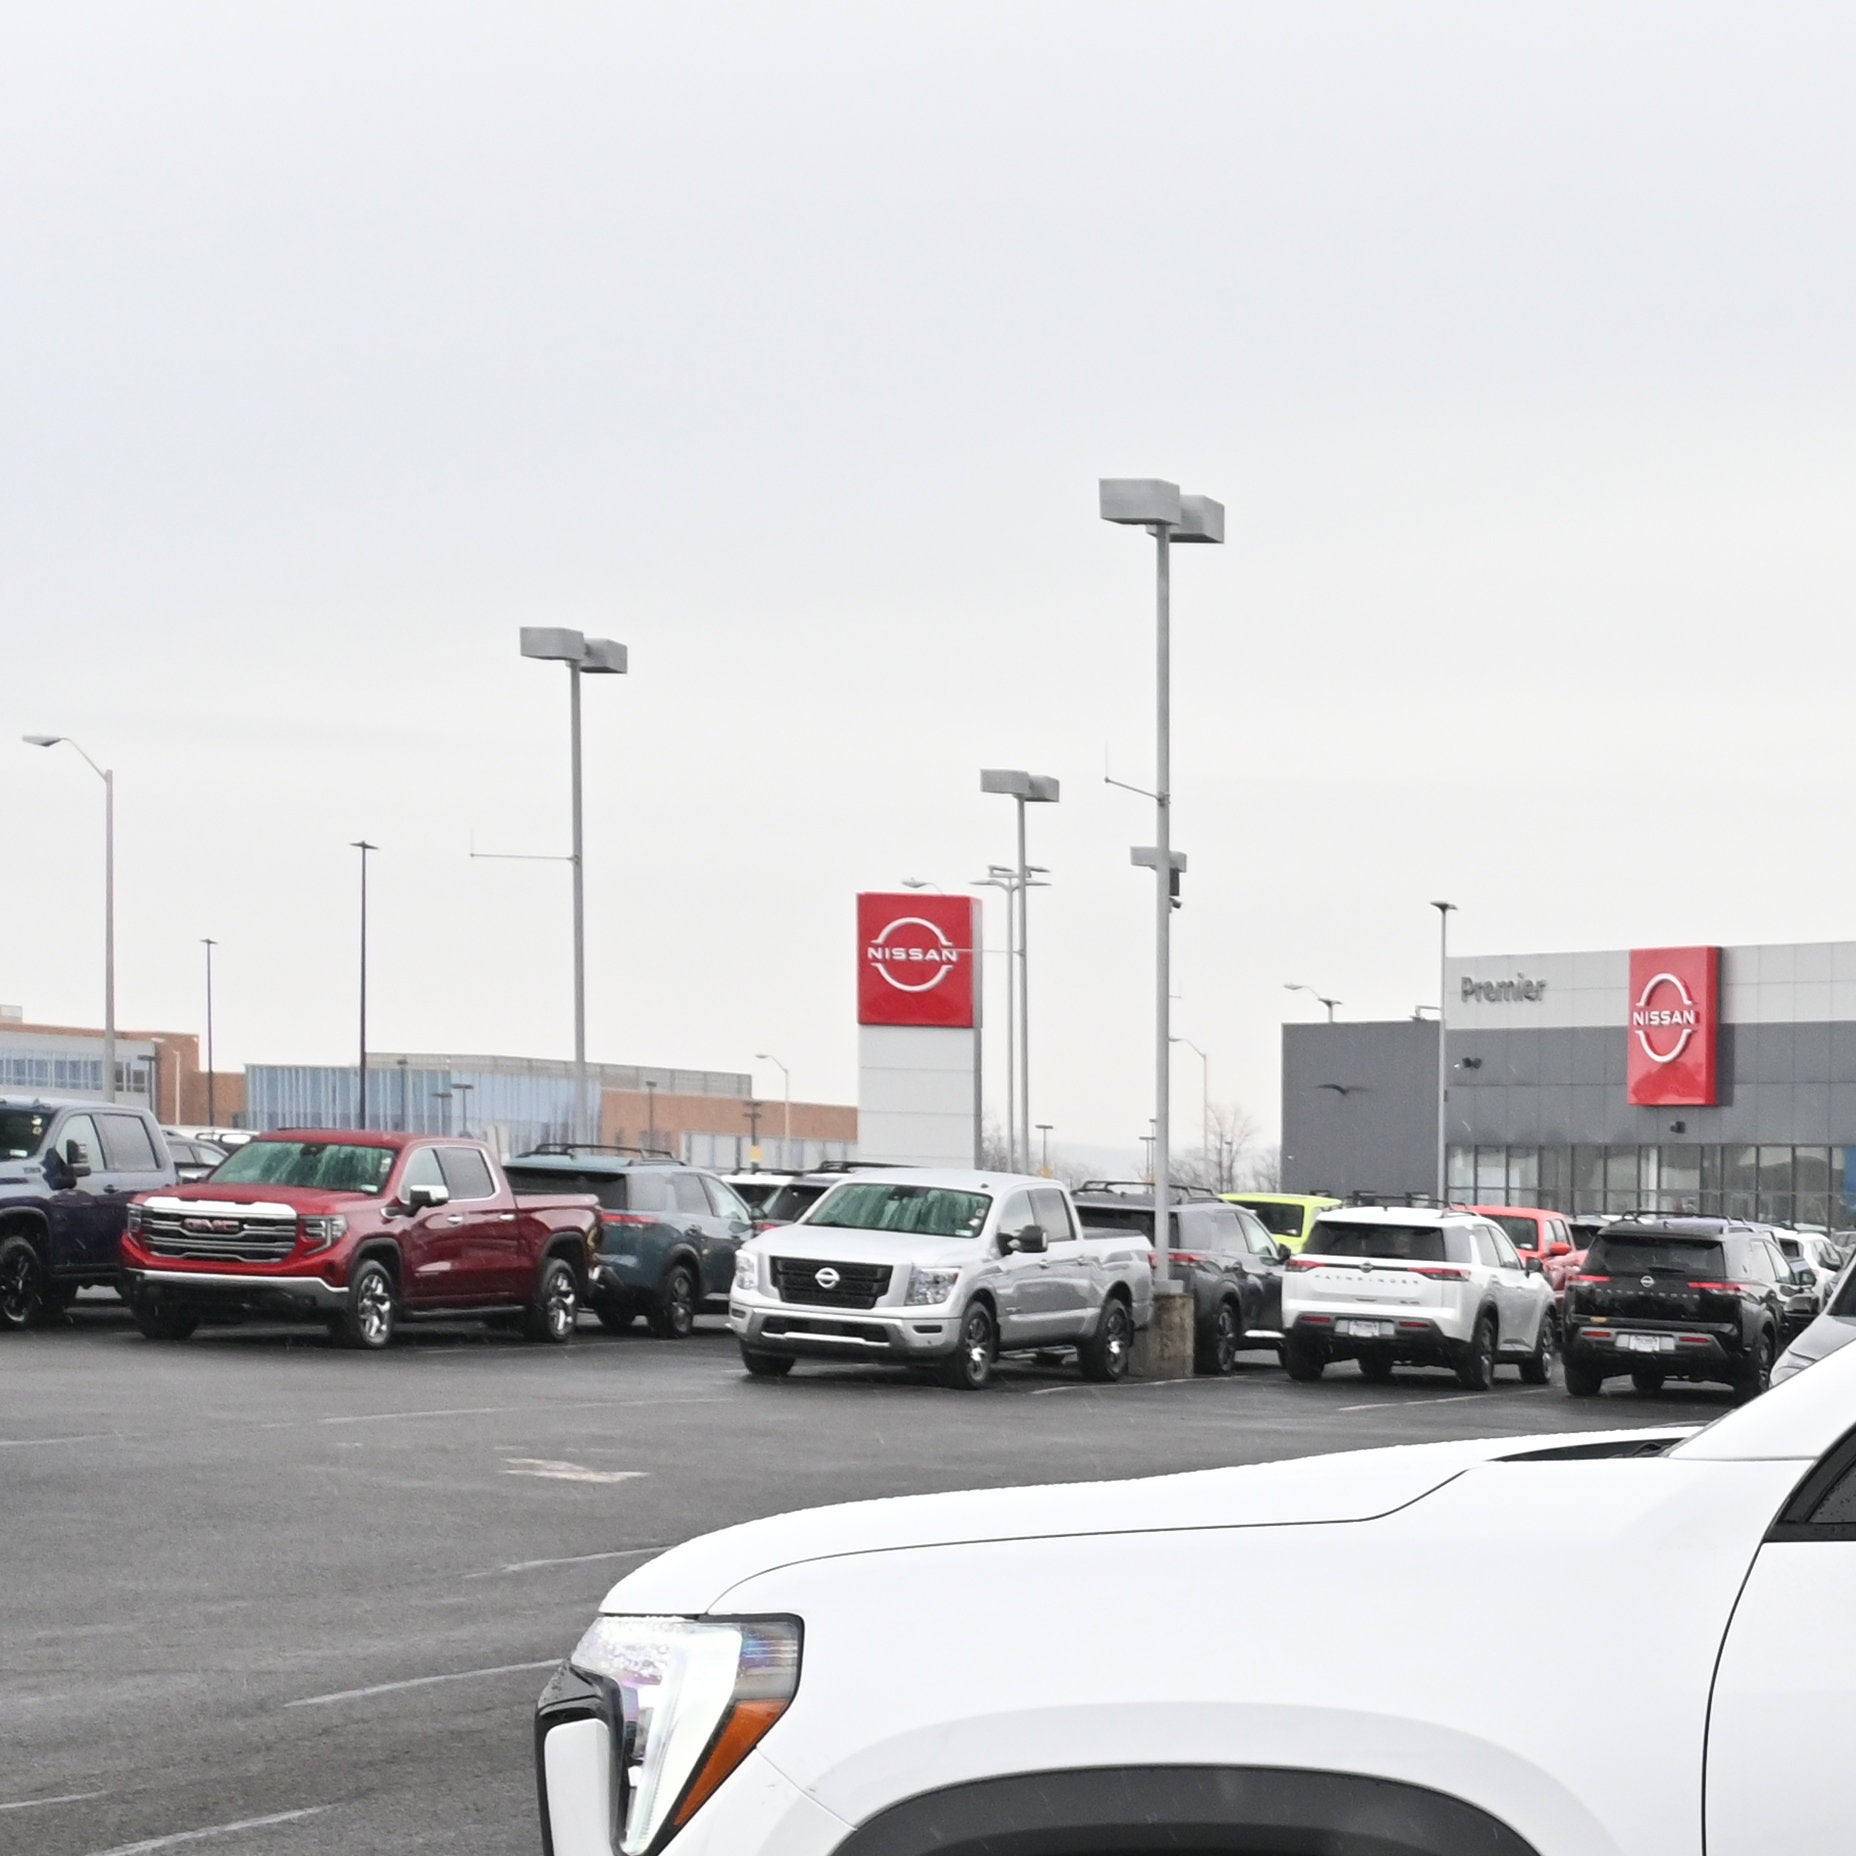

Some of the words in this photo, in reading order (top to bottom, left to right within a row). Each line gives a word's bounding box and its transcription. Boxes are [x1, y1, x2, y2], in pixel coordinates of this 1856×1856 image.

[867, 947, 957, 962] NISSAN
[1461, 972, 1546, 1003] Premier
[1632, 1010, 1696, 1027] NISSAN
